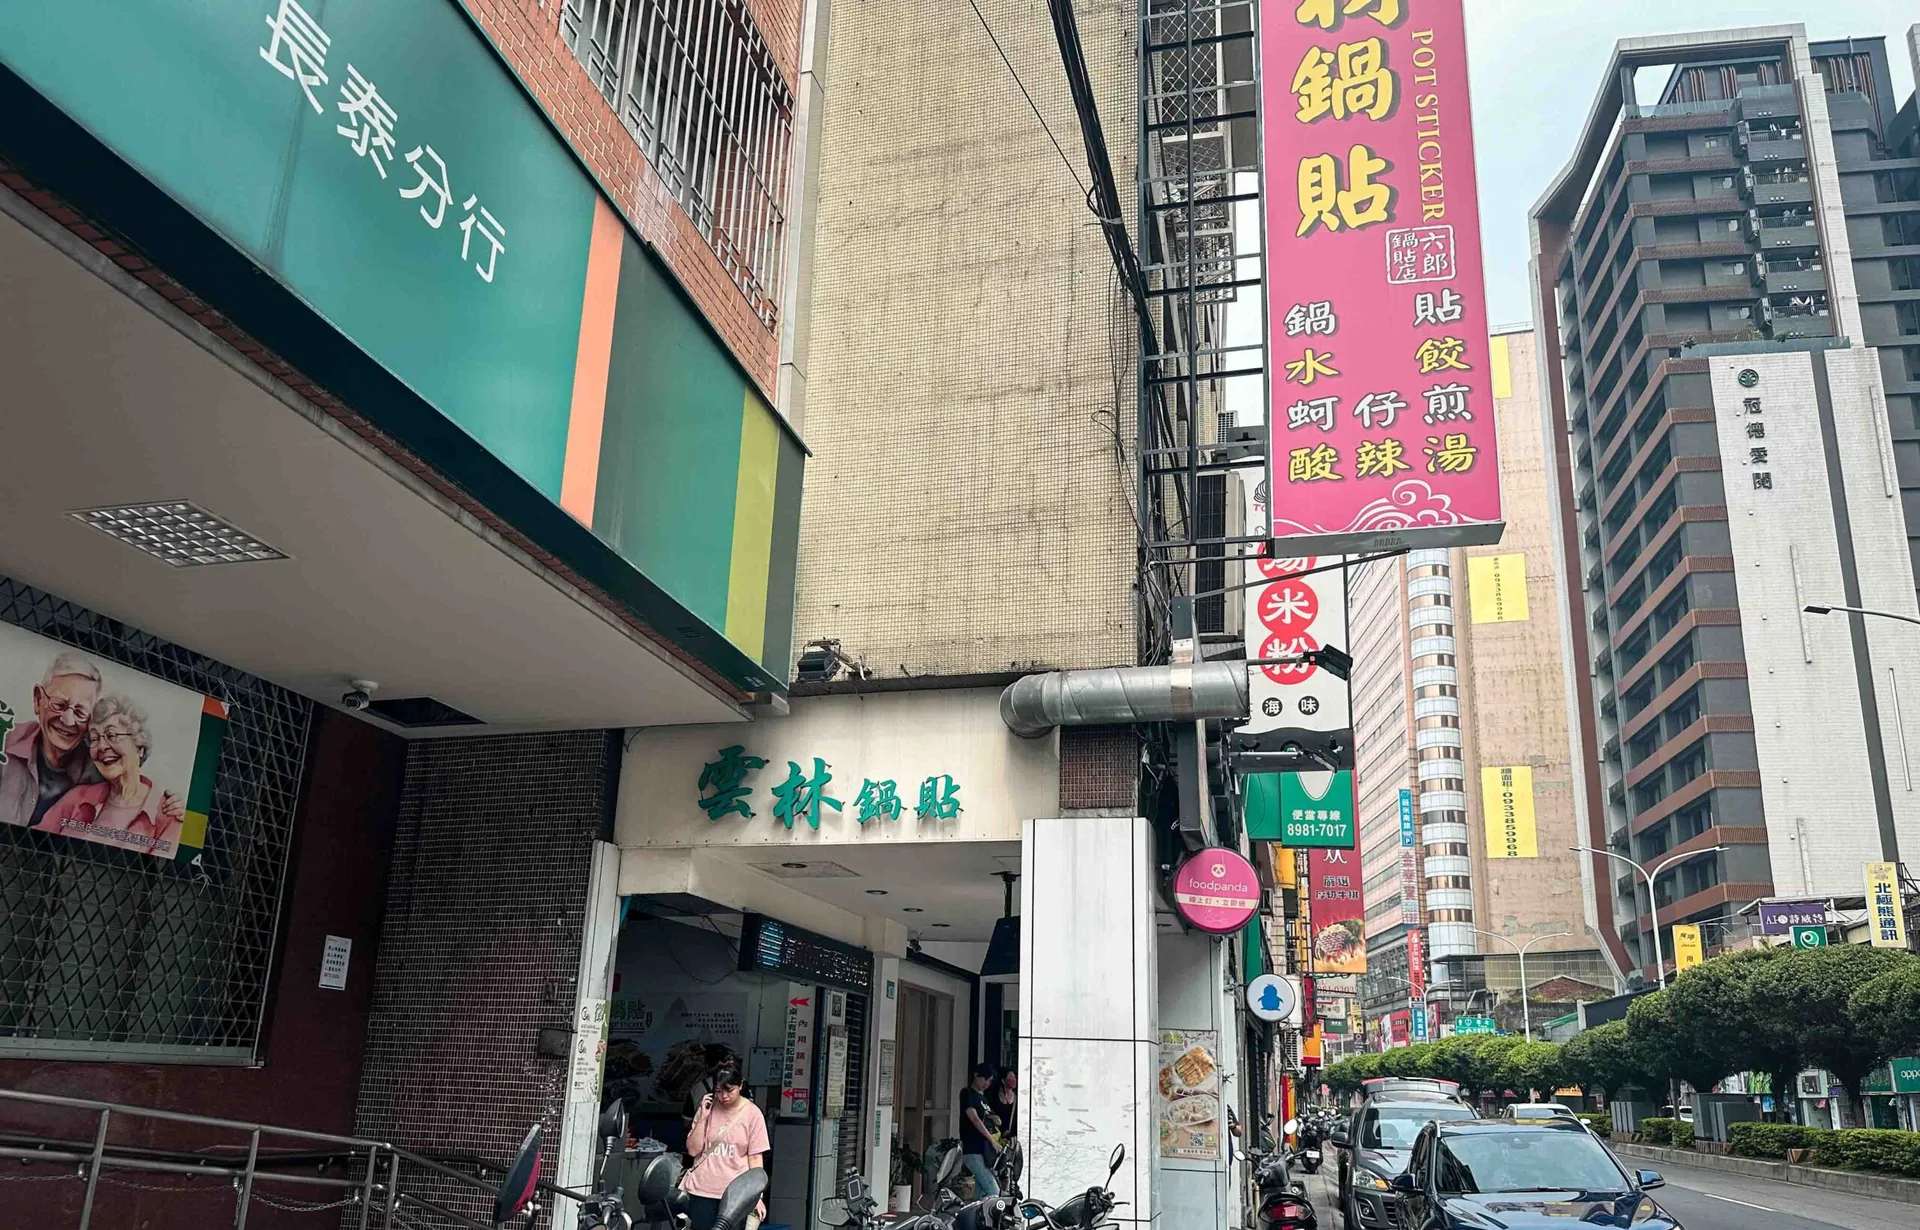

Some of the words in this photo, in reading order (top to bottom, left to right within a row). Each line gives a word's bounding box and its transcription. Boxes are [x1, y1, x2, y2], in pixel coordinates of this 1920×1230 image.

[1411, 28, 1437, 87] POT
[259, 0, 507, 283] 長泰分行
[1415, 94, 1446, 222] STICKER
[1391, 232, 1419, 281] 鍋貼店
[1420, 231, 1448, 275] 六郎
[1264, 697, 1318, 715] 海味
[698, 745, 965, 830] 雲林鍋貼
[1287, 824, 1347, 837] 8981-7017
[1503, 792, 1518, 857] 0933859968
[1188, 878, 1248, 893] foodpanda
[1874, 882, 1899, 941] 北極熊通訊
